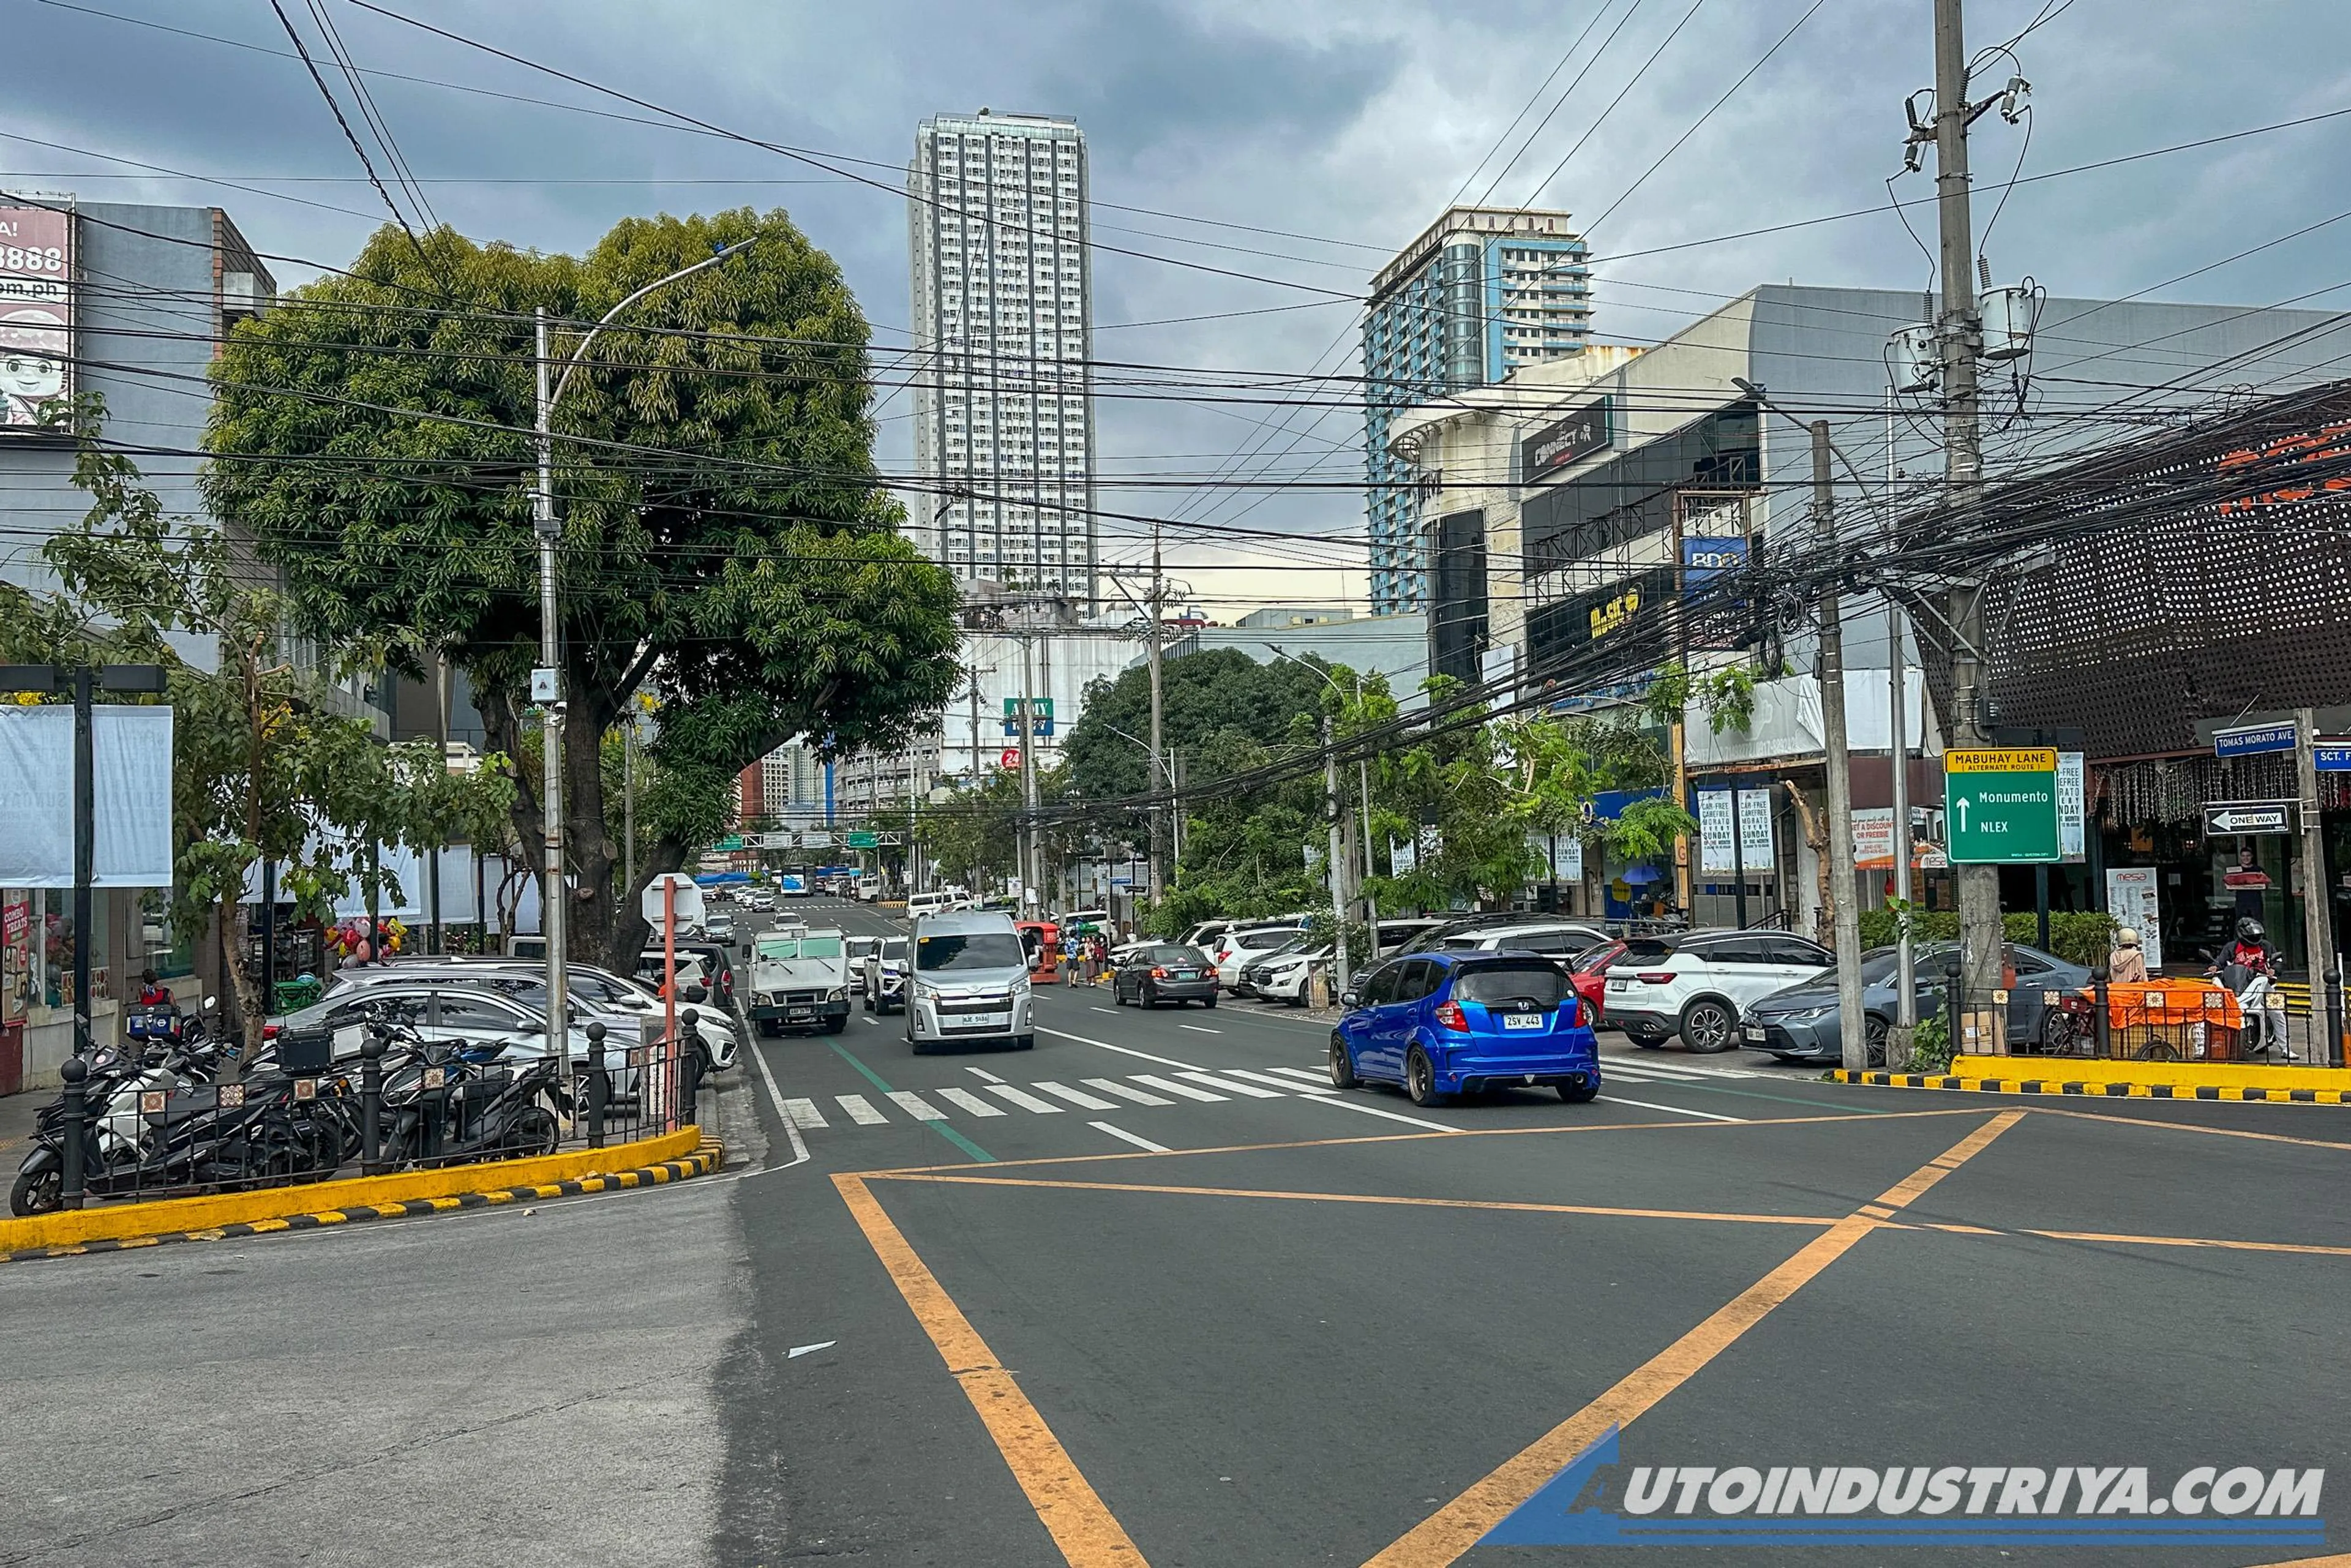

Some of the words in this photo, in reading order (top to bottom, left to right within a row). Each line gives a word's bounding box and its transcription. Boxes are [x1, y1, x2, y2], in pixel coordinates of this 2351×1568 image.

[1692, 552, 1739, 568] BDO
[2219, 737, 2243, 748] TOMAS
[2244, 733, 2275, 745] MORATO
[2277, 731, 2294, 740] AVE.
[1955, 754, 2012, 763] MABUHAY
[2017, 753, 2046, 763] LANE
[2320, 752, 2341, 761] SCT.
[2060, 768, 2079, 776] -FREE
[2059, 778, 2079, 786] EFREE
[1979, 790, 2048, 803] Monumento
[2058, 805, 2079, 814] NDAY
[1981, 821, 2008, 833] NLEX
[1703, 831, 1730, 841] SUNDAY
[1742, 830, 1768, 839] SUNDAY
[2116, 873, 2147, 882] mesa
[1526, 1016, 1539, 1025] 443
